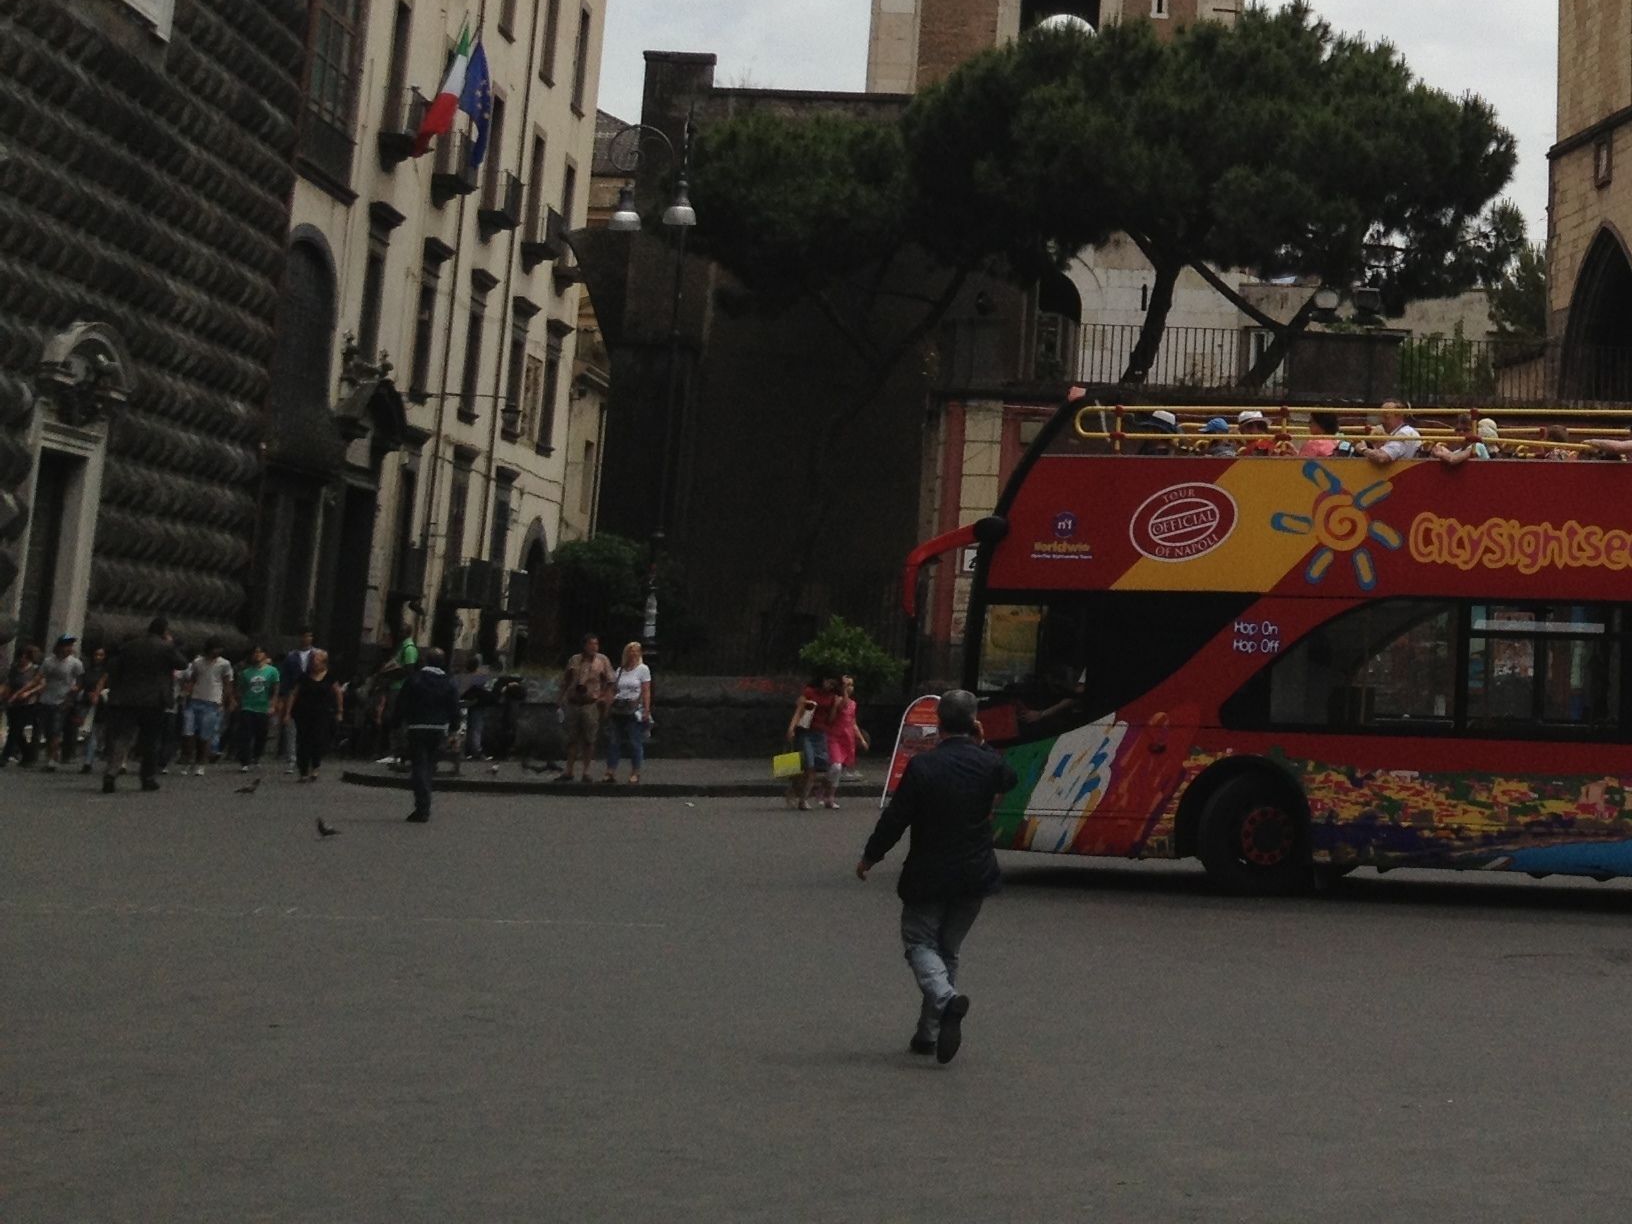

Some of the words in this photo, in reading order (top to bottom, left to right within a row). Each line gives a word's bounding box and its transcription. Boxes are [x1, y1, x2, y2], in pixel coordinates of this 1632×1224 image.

[1161, 488, 1196, 503] TOUR
[1151, 509, 1214, 536] OFFICIAL
[1155, 545, 1170, 557] OF
[1174, 533, 1219, 557] NAPOLI
[1233, 621, 1258, 636] Hop
[1261, 620, 1279, 635] On
[1232, 638, 1258, 654] Hop
[1260, 638, 1280, 653] Off
